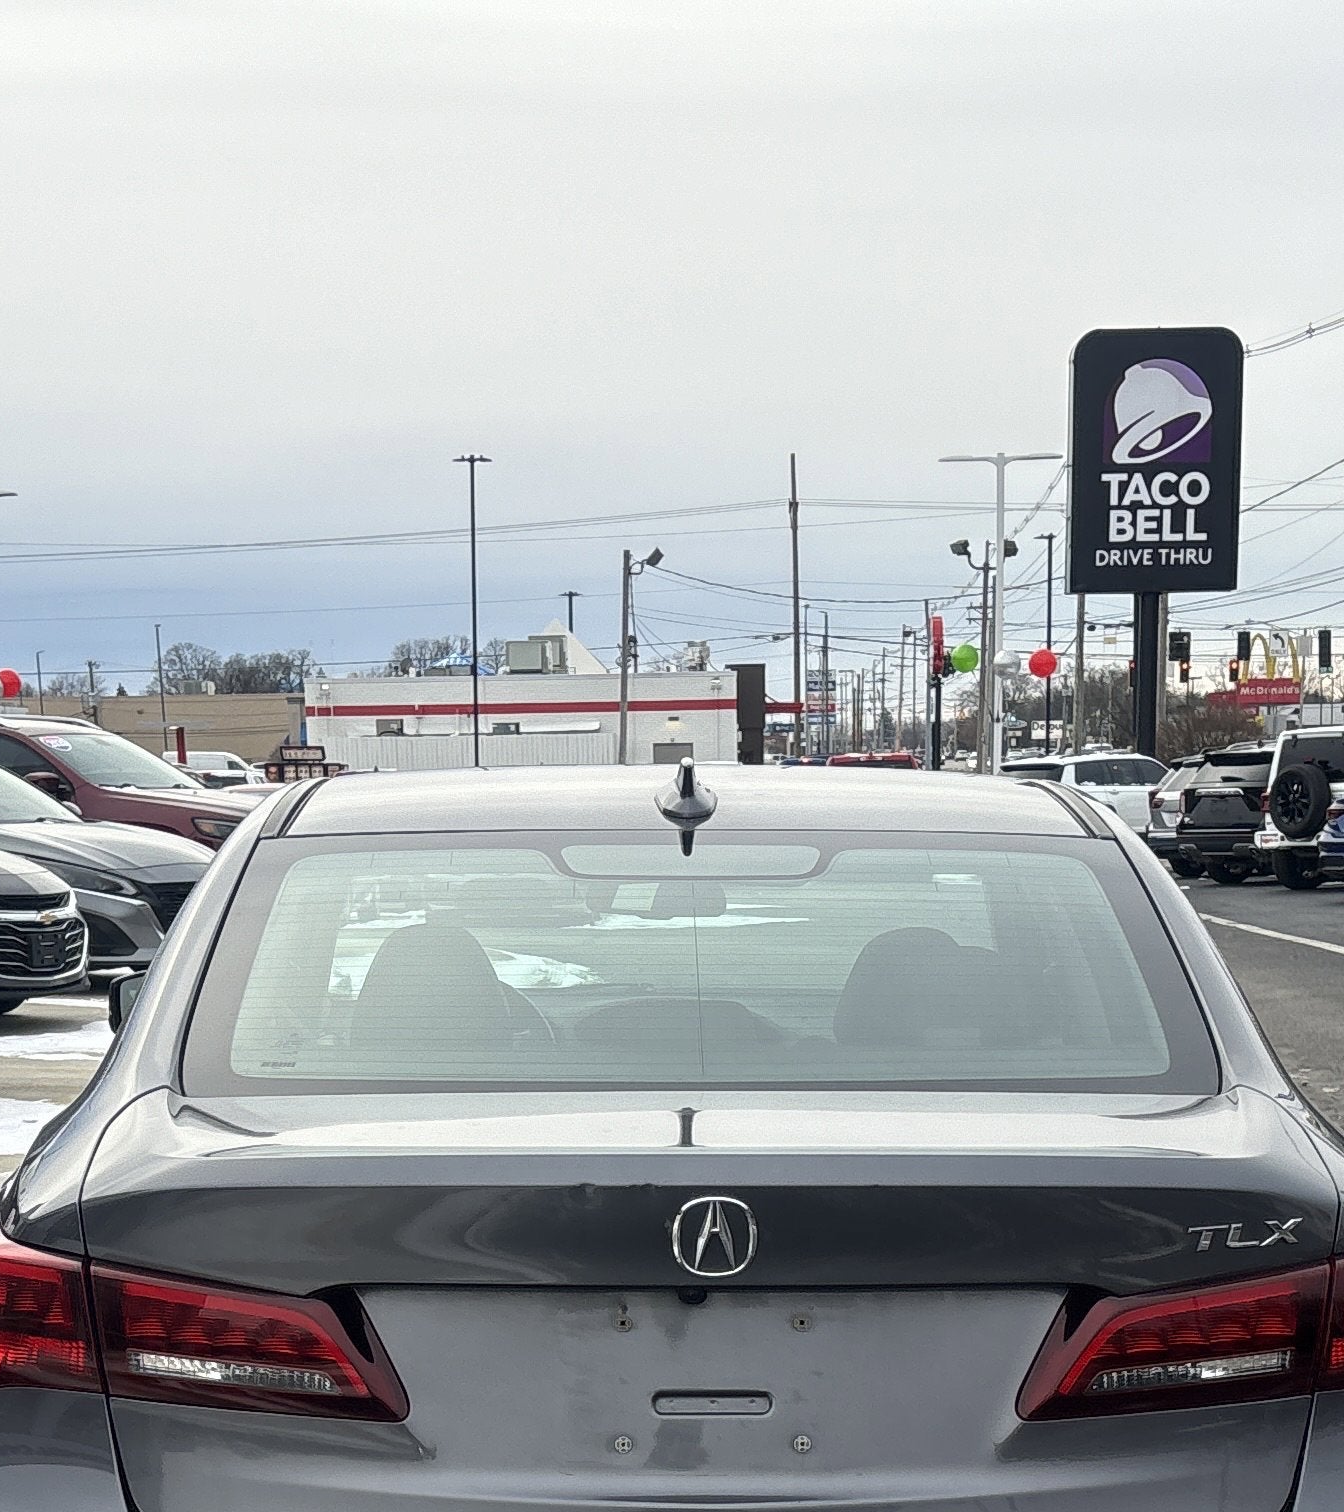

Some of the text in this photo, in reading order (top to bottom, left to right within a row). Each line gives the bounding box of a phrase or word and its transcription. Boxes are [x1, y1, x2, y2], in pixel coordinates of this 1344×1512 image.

[1101, 471, 1211, 506] TACO
[1108, 508, 1208, 542] BELL
[1095, 548, 1213, 567] DRIVE THRU
[1187, 1217, 1304, 1252] TLX
